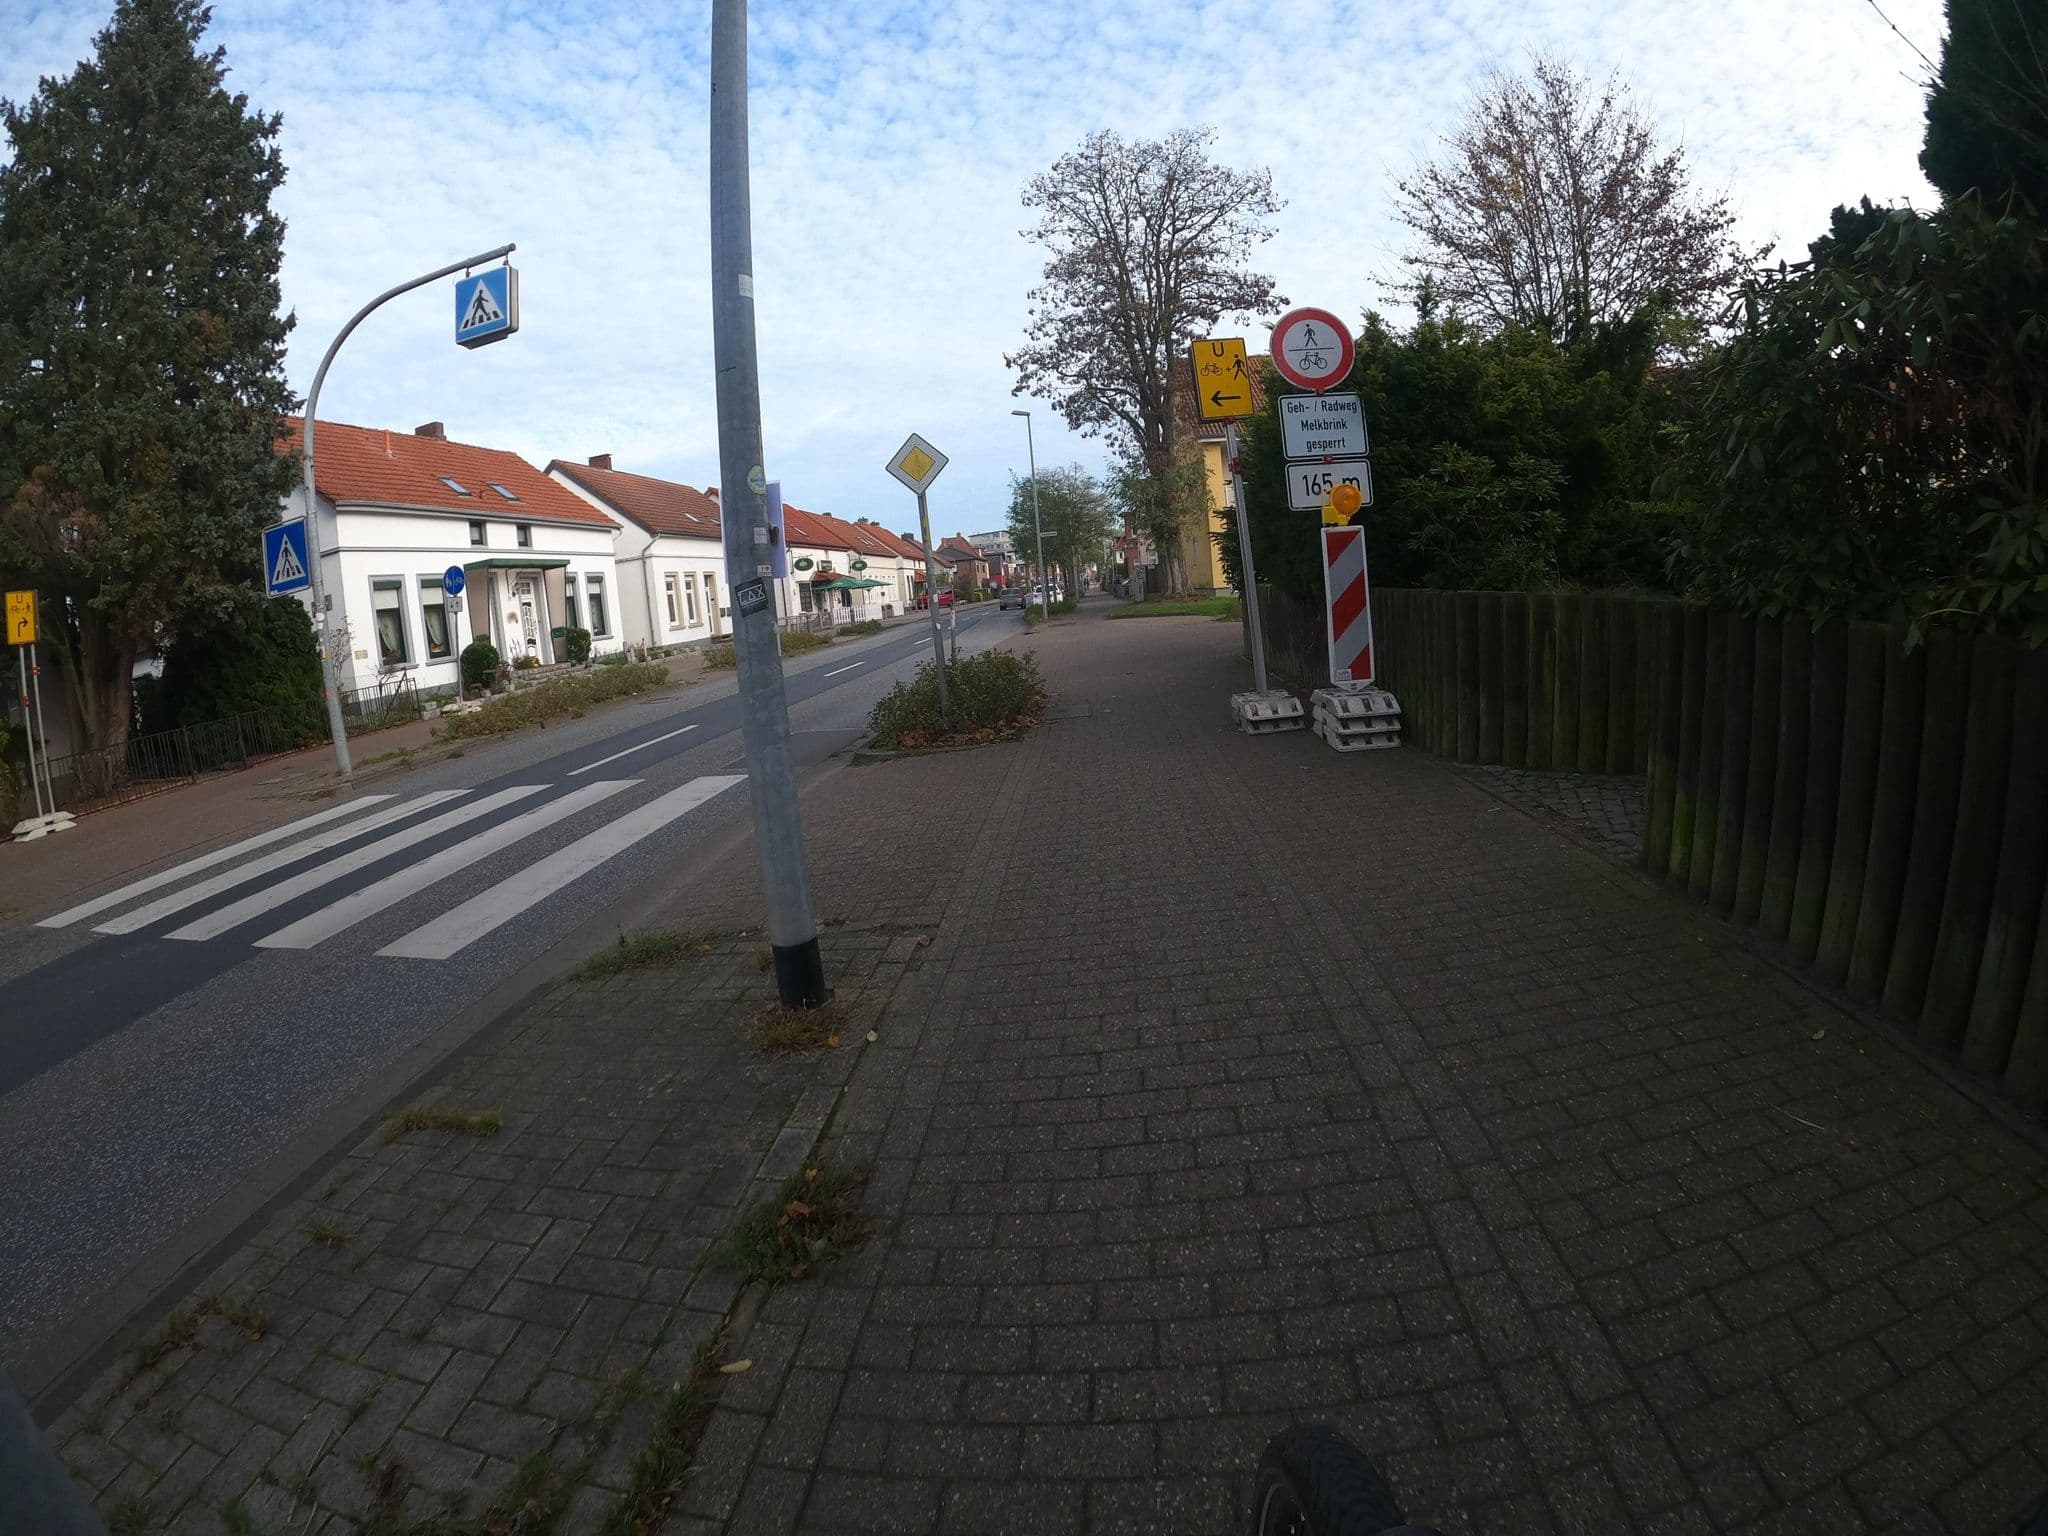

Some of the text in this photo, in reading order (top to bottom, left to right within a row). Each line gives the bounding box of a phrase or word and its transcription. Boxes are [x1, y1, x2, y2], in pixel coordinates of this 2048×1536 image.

[1212, 342, 1224, 357] U
[1287, 400, 1310, 413] Geh-
[1321, 399, 1357, 414] Radweg
[1301, 418, 1347, 432] Melkbrink
[1306, 437, 1346, 452] gesperrt
[1302, 473, 1333, 496] 165
[16, 592, 23, 603] U
